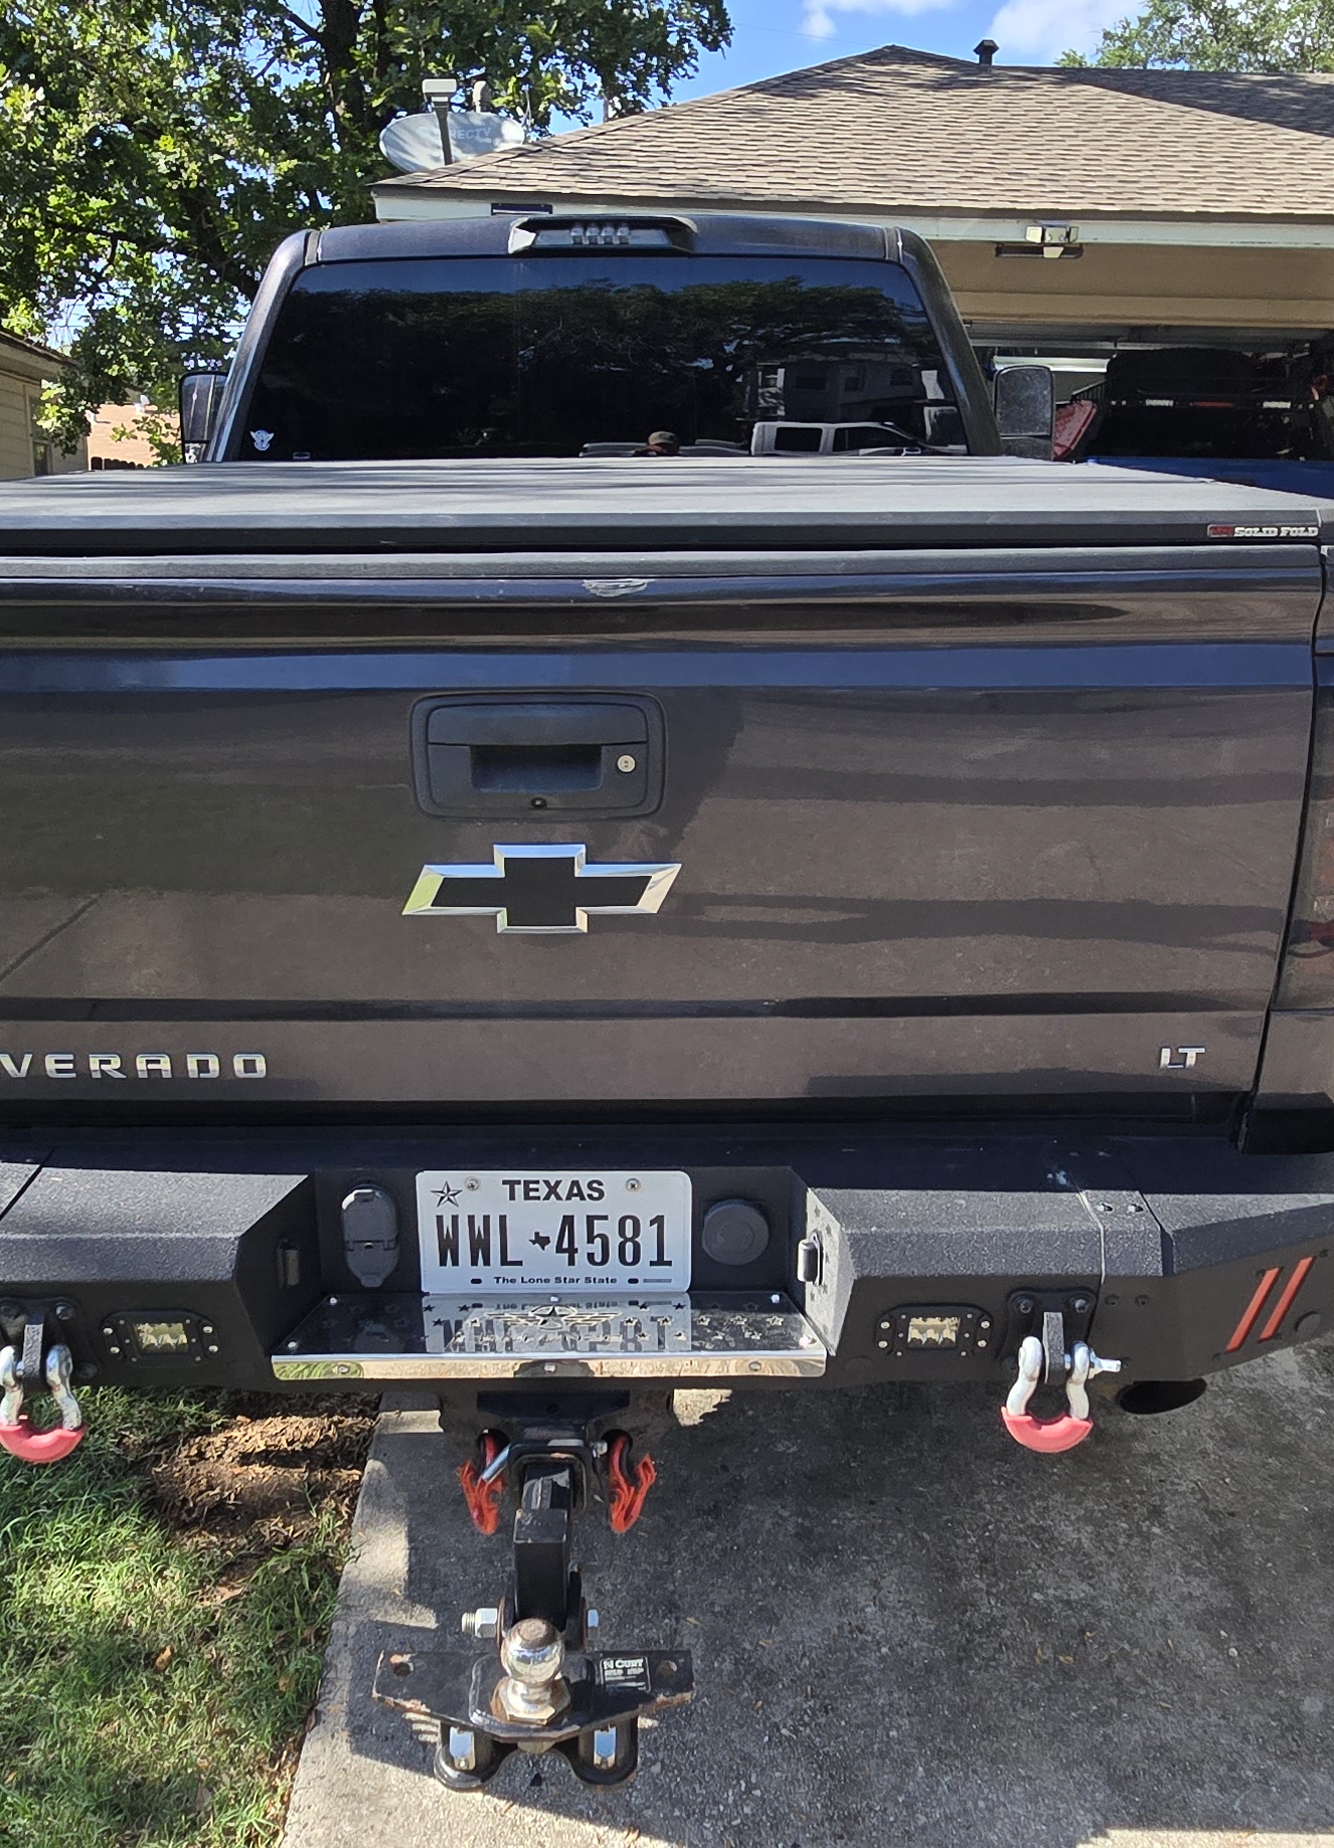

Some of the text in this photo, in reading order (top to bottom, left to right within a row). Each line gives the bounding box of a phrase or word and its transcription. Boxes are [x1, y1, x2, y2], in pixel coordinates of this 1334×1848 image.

[441, 128, 492, 140] RECTV
[1233, 526, 1278, 538] SOLID
[1279, 526, 1319, 538] FOLD
[1159, 1047, 1206, 1070] LT
[501, 1179, 606, 1202] TEXAS
[493, 1275, 618, 1285] The Lone Star State
